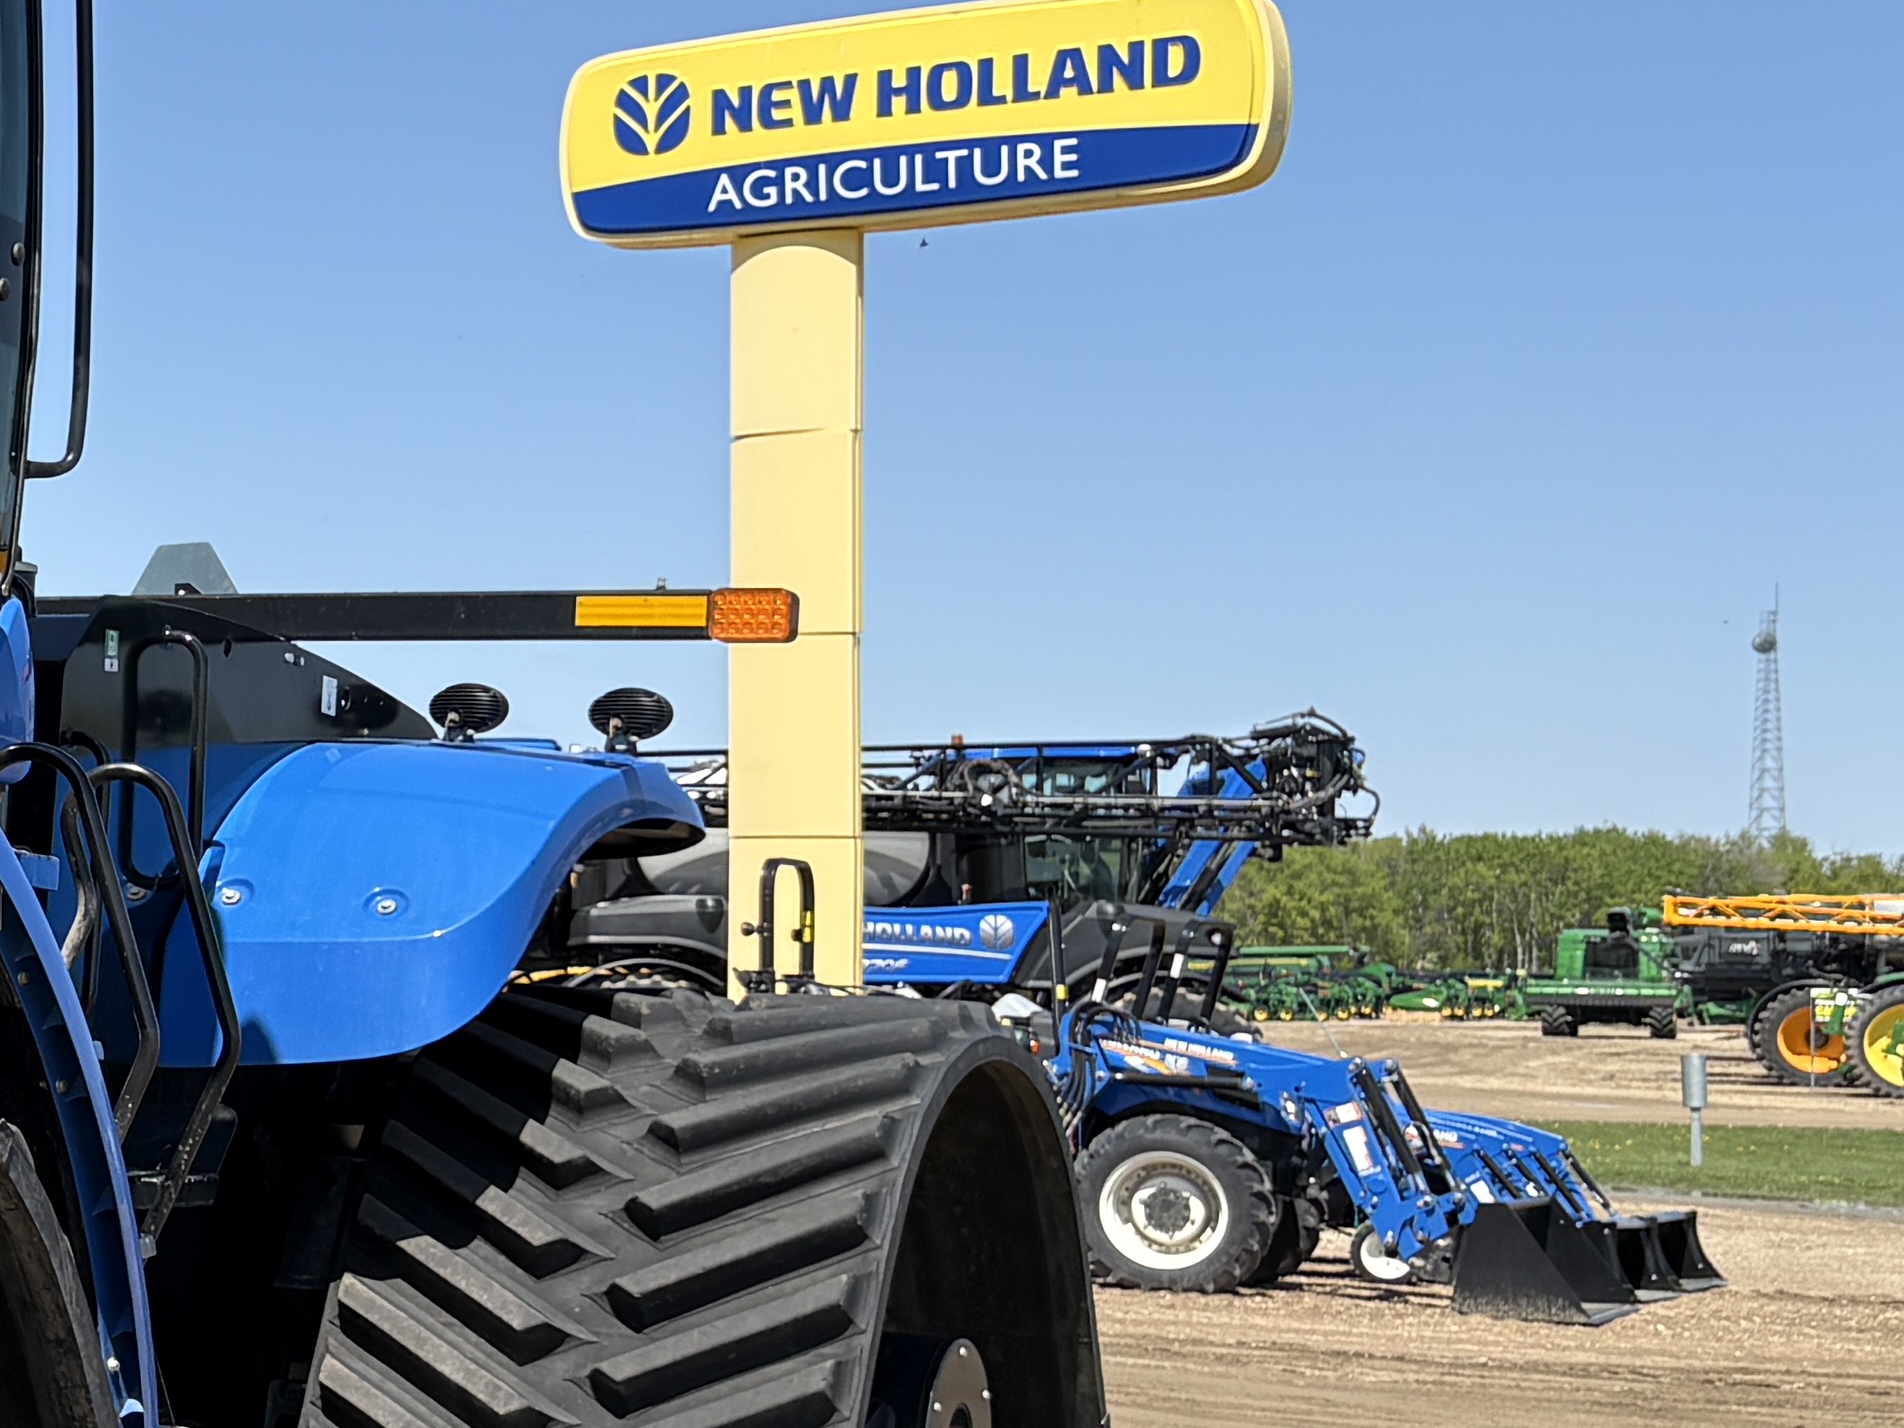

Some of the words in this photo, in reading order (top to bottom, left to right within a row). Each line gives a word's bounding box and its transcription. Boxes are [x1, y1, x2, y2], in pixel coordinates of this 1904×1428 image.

[710, 72, 859, 137] NEW
[875, 34, 1202, 118] HOLLAND
[706, 137, 1080, 214] AGRICULTURE
